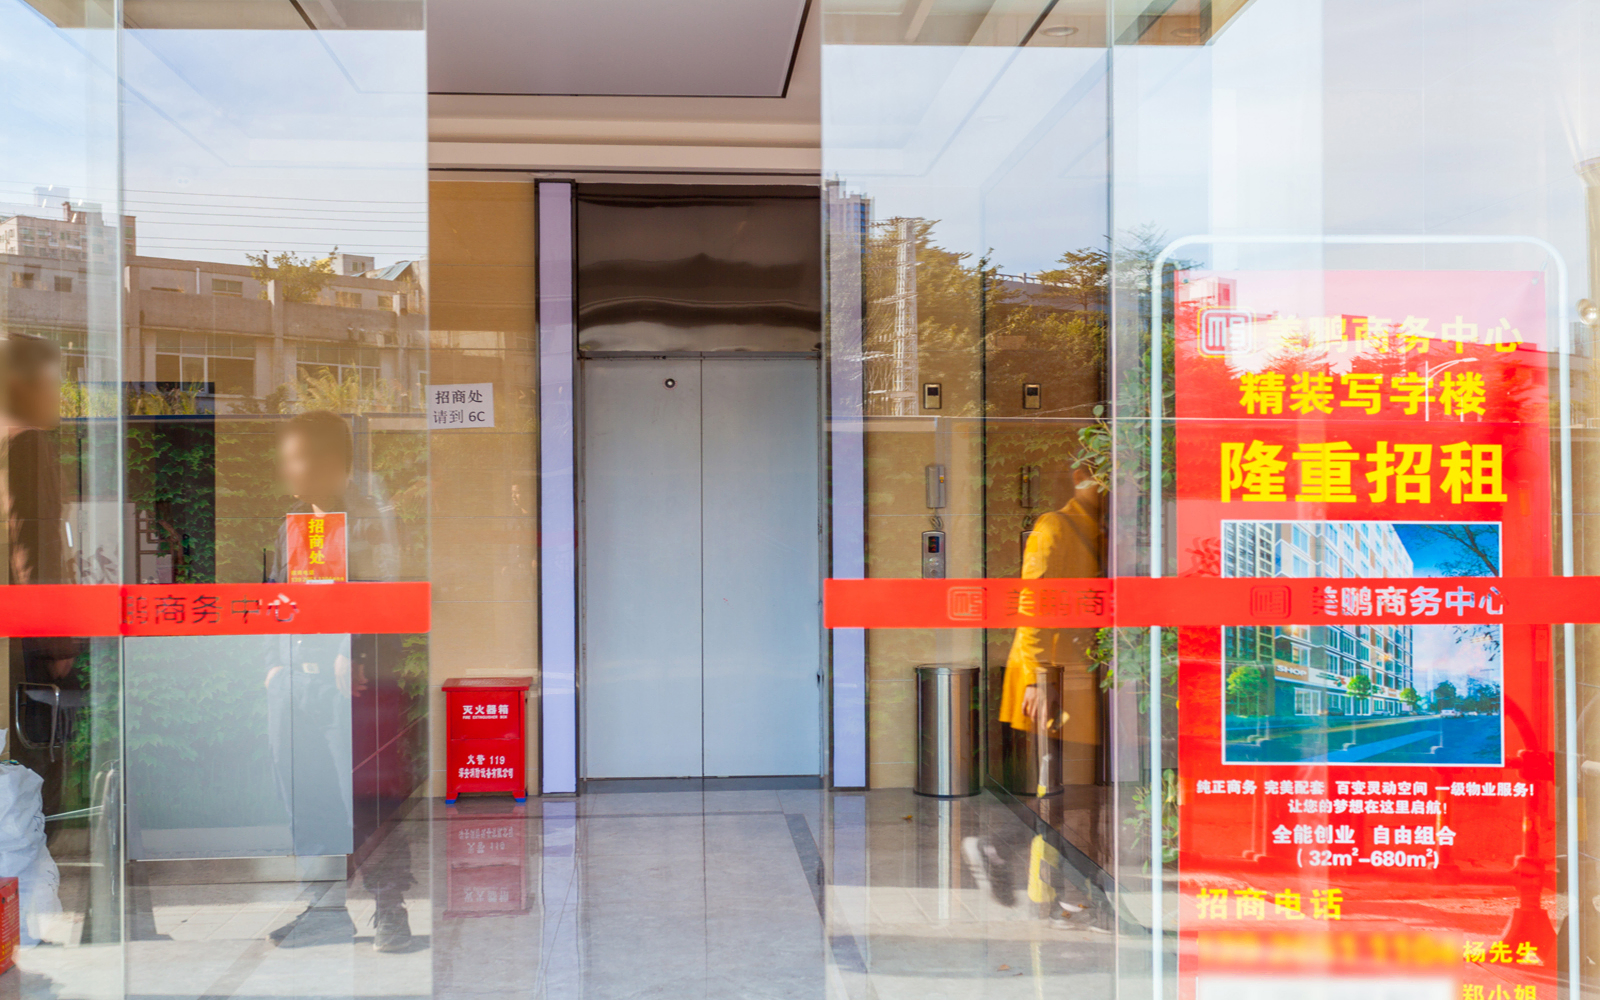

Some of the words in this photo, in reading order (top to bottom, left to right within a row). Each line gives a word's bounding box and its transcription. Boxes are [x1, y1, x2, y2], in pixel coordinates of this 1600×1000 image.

[1266, 314, 1524, 354] 美鹏商务中心
[435, 389, 483, 405] 招商处
[1239, 371, 1486, 415] 精装写字楼
[433, 409, 464, 424] 请到
[468, 410, 486, 423] 6C
[1220, 440, 1508, 504] 隆重招租
[307, 518, 326, 565] 招商处
[1312, 585, 1507, 617] 美鹏商务中心
[1276, 665, 1307, 676] SHOP
[462, 704, 509, 715] 灭火器箱
[489, 755, 506, 765] 119
[1196, 780, 1257, 795] 纯正商务
[1264, 780, 1326, 796] 完美配套
[1335, 781, 1428, 797] 百变灵动空间
[1434, 781, 1535, 799] 一级物业服务!
[1272, 824, 1356, 845] 全能创业
[1373, 825, 1457, 846] 自由组合
[1196, 887, 1344, 921] 招商电话
[1463, 940, 1539, 964] 杨先生
